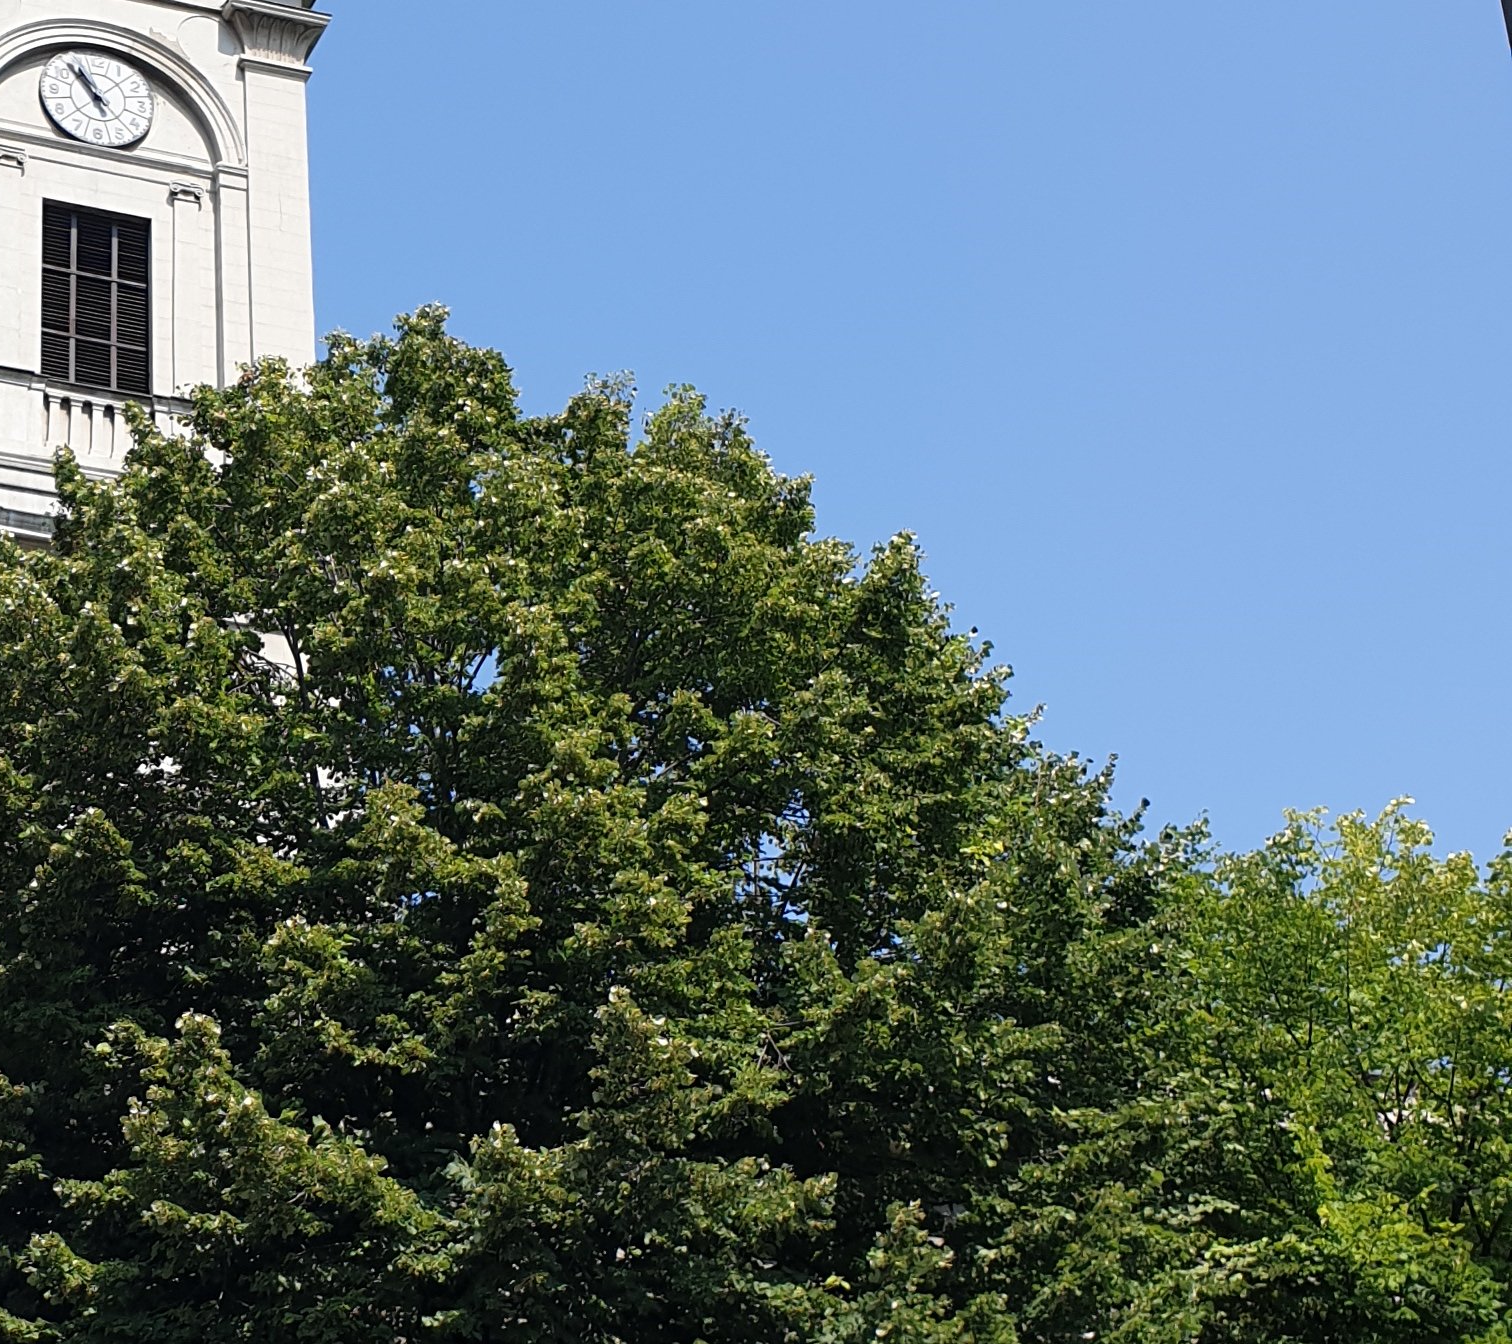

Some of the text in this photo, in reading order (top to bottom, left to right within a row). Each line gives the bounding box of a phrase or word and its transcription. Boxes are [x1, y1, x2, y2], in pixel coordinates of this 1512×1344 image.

[49, 83, 60, 94] 9
[130, 81, 140, 93] 2
[55, 103, 65, 115] 8
[137, 100, 147, 113] 3
[72, 118, 83, 131] 7
[129, 118, 140, 130] 4
[92, 128, 104, 140] 6
[114, 127, 124, 140] 5
